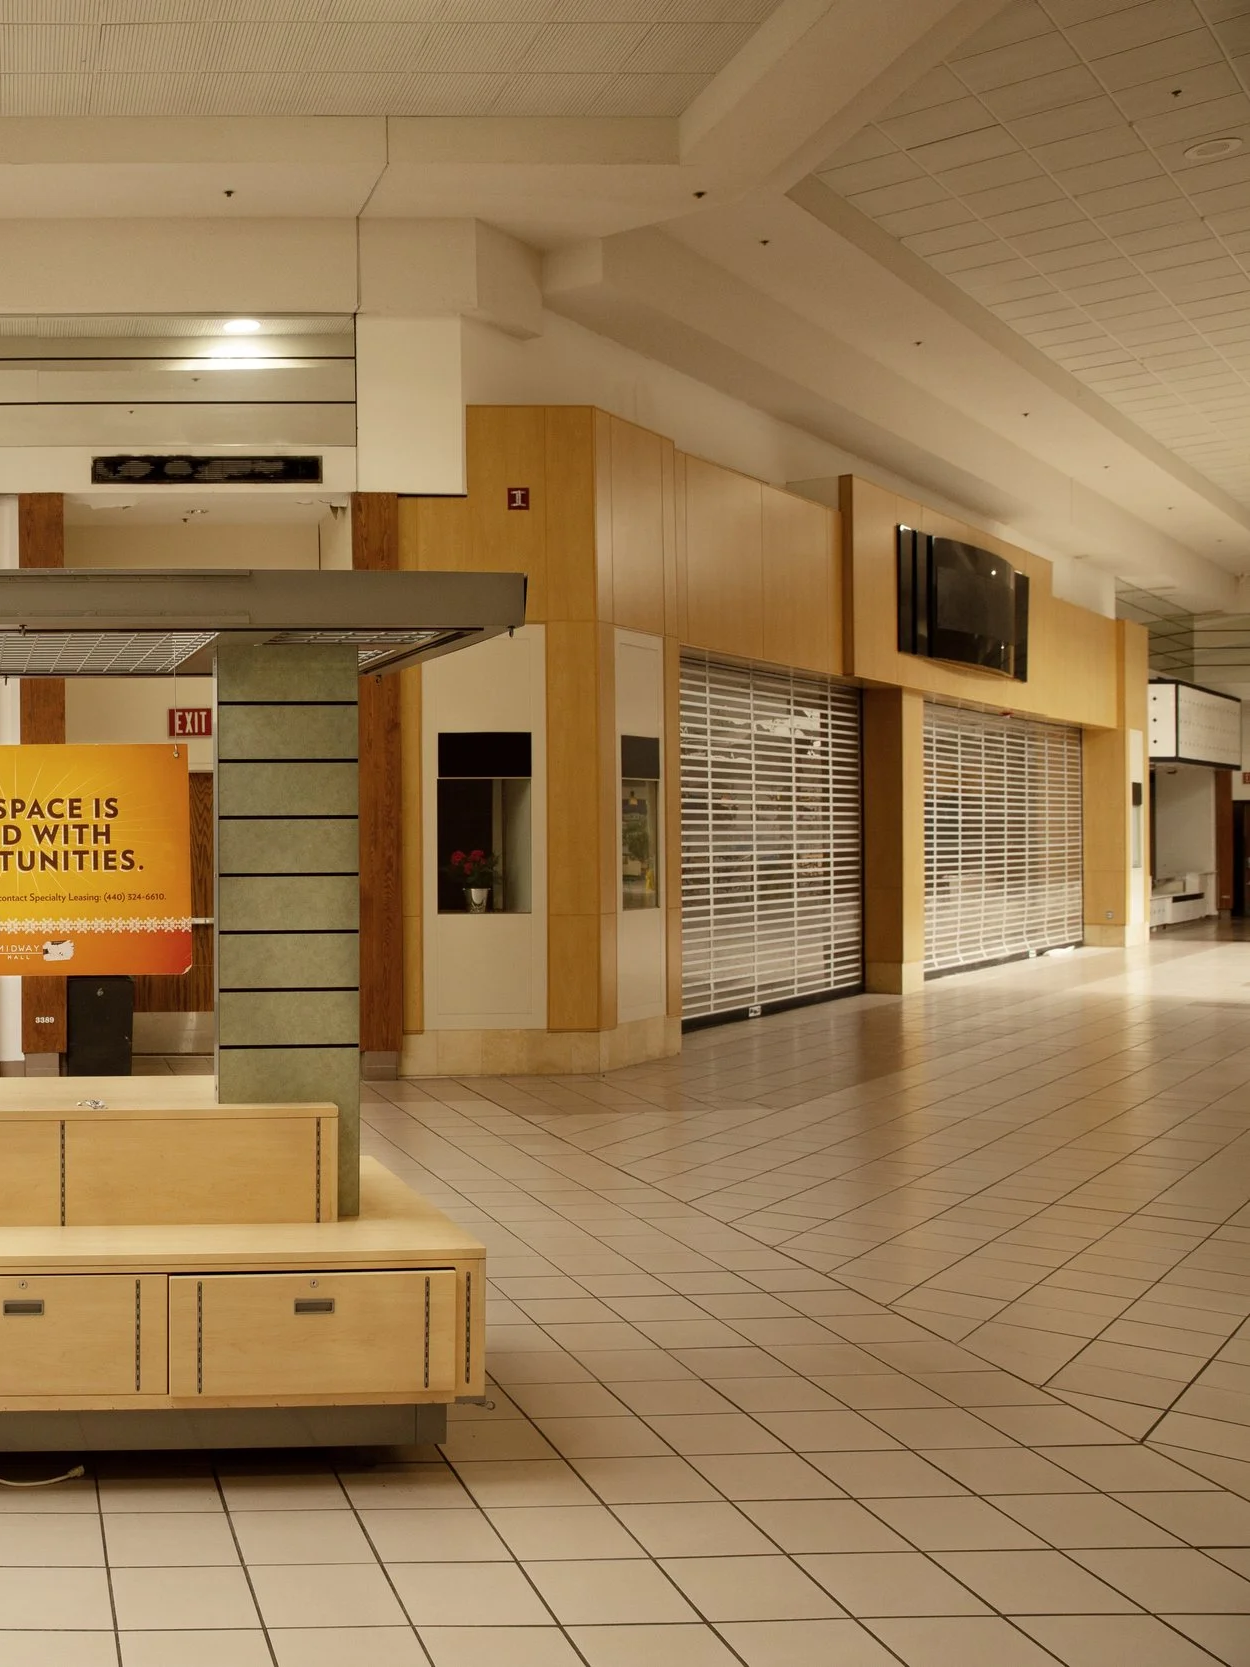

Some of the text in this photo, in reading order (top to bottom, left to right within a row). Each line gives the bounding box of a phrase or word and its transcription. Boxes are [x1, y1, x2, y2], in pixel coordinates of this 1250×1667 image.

[176, 711, 207, 733] EXIT
[93, 797, 119, 820] IS
[32, 824, 111, 846] WITH
[29, 893, 66, 903] Specialty
[68, 893, 101, 903] Leasing:
[103, 892, 125, 903] (440)
[128, 893, 167, 901] 324-6610.
[35, 1016, 55, 1024] 3389
